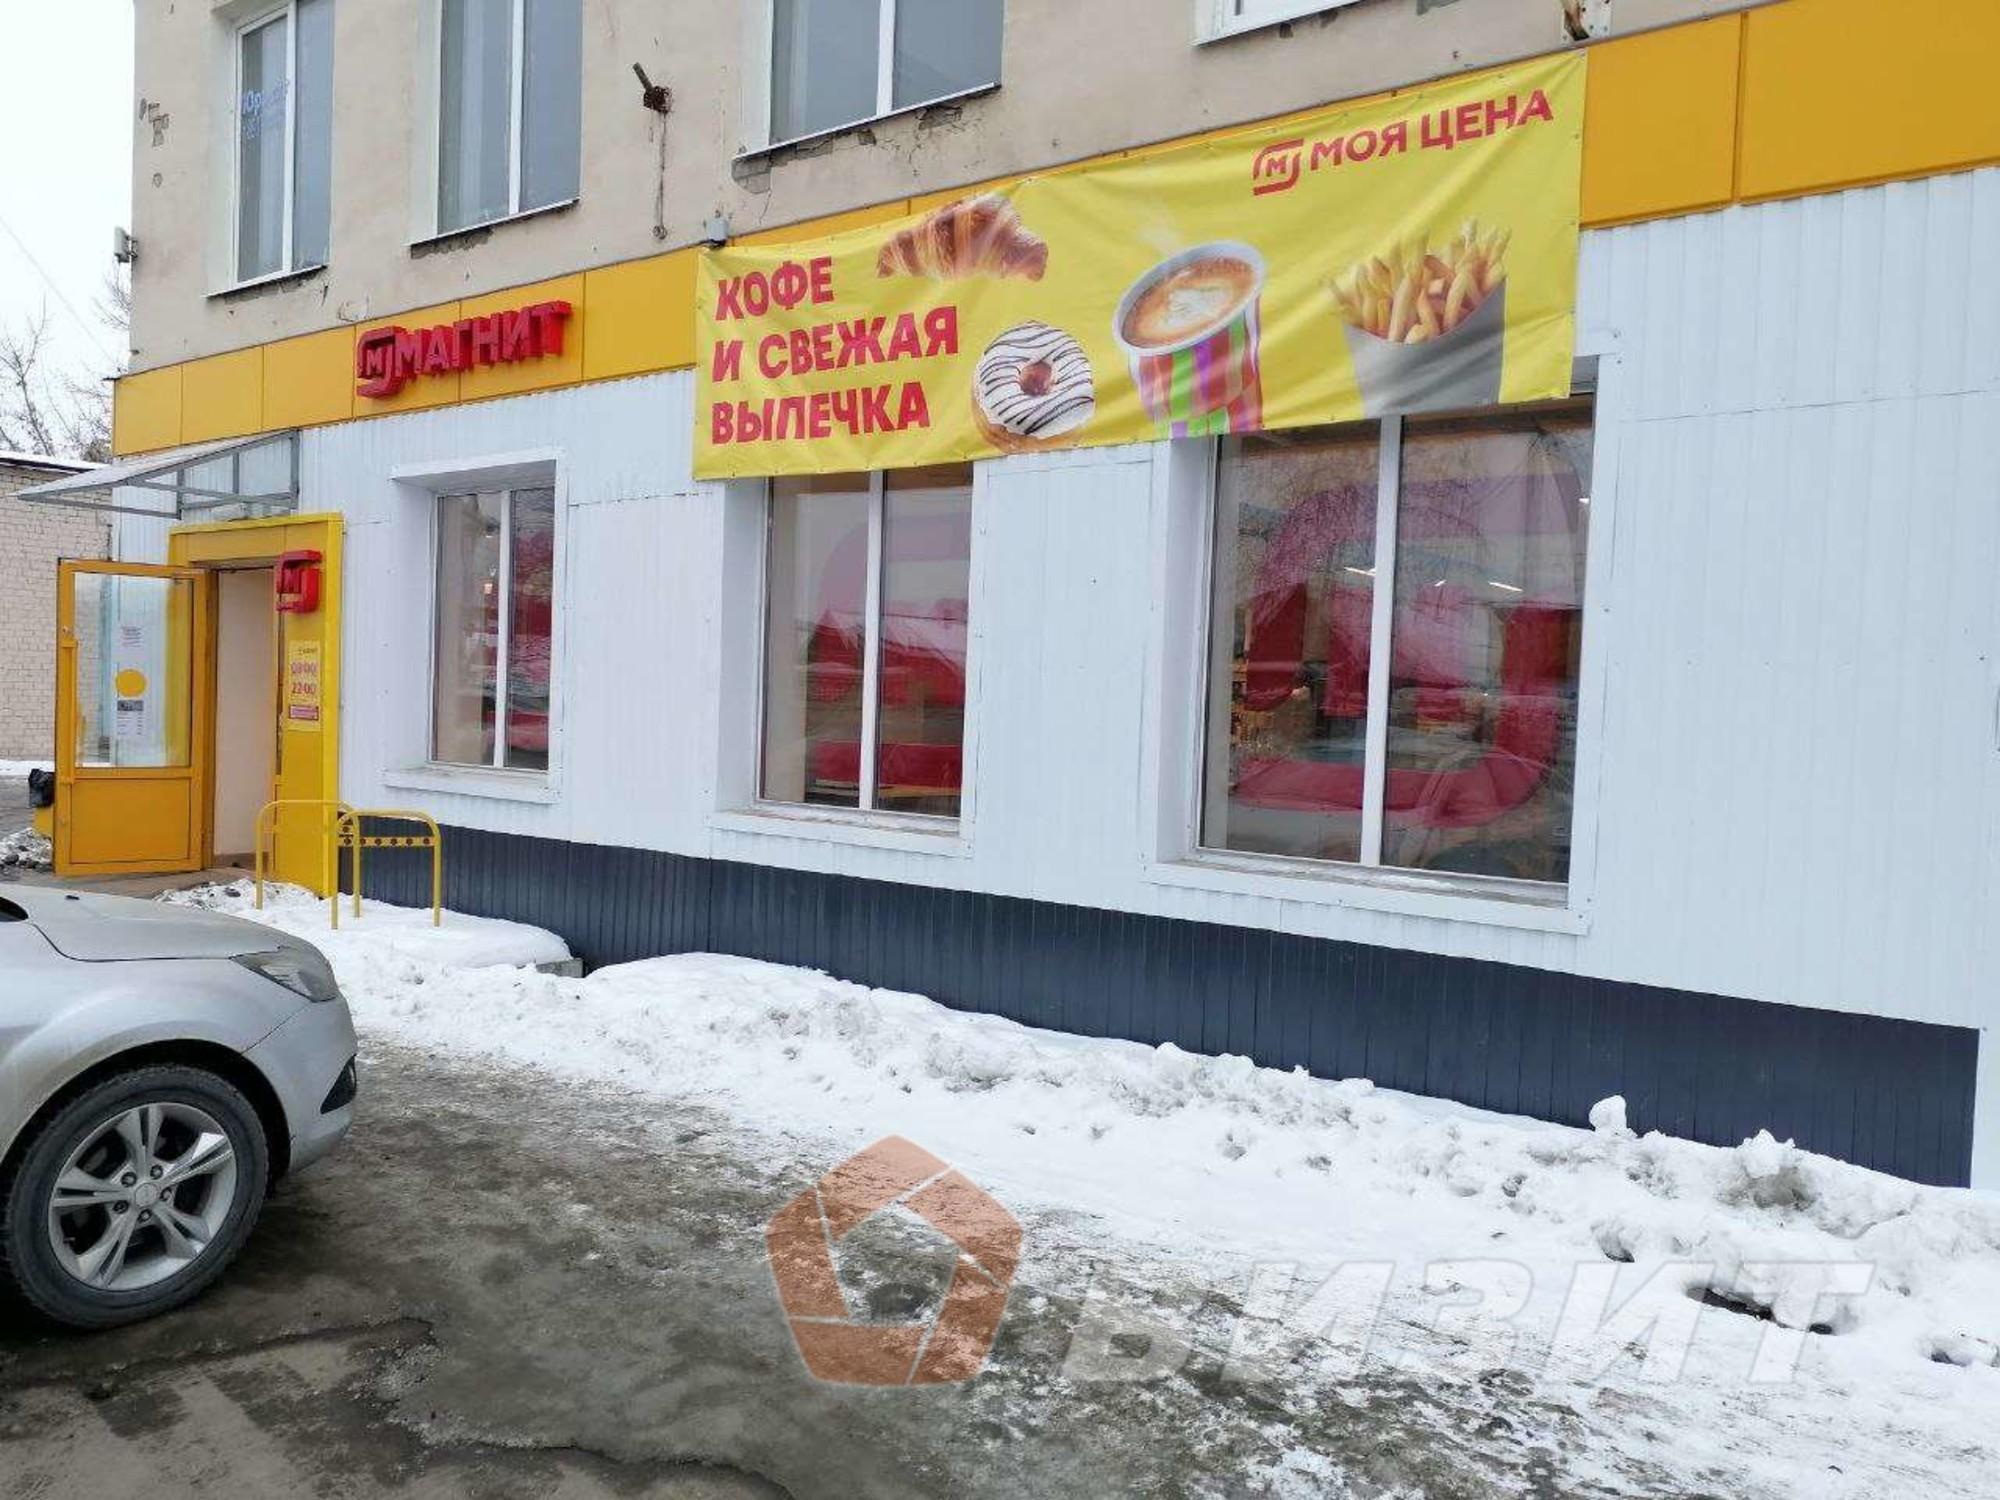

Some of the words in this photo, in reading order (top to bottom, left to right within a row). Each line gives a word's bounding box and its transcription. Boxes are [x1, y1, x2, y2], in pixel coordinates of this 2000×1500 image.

[1309, 120, 1409, 171] МОЯ
[1420, 88, 1554, 150] ЦЕНА
[717, 257, 834, 320] КОФЕ
[395, 300, 572, 379] МАГНИТ
[712, 341, 742, 382] И
[759, 306, 959, 380] СВЕЖАЯ
[711, 381, 931, 445] ВЫПЕЧКА
